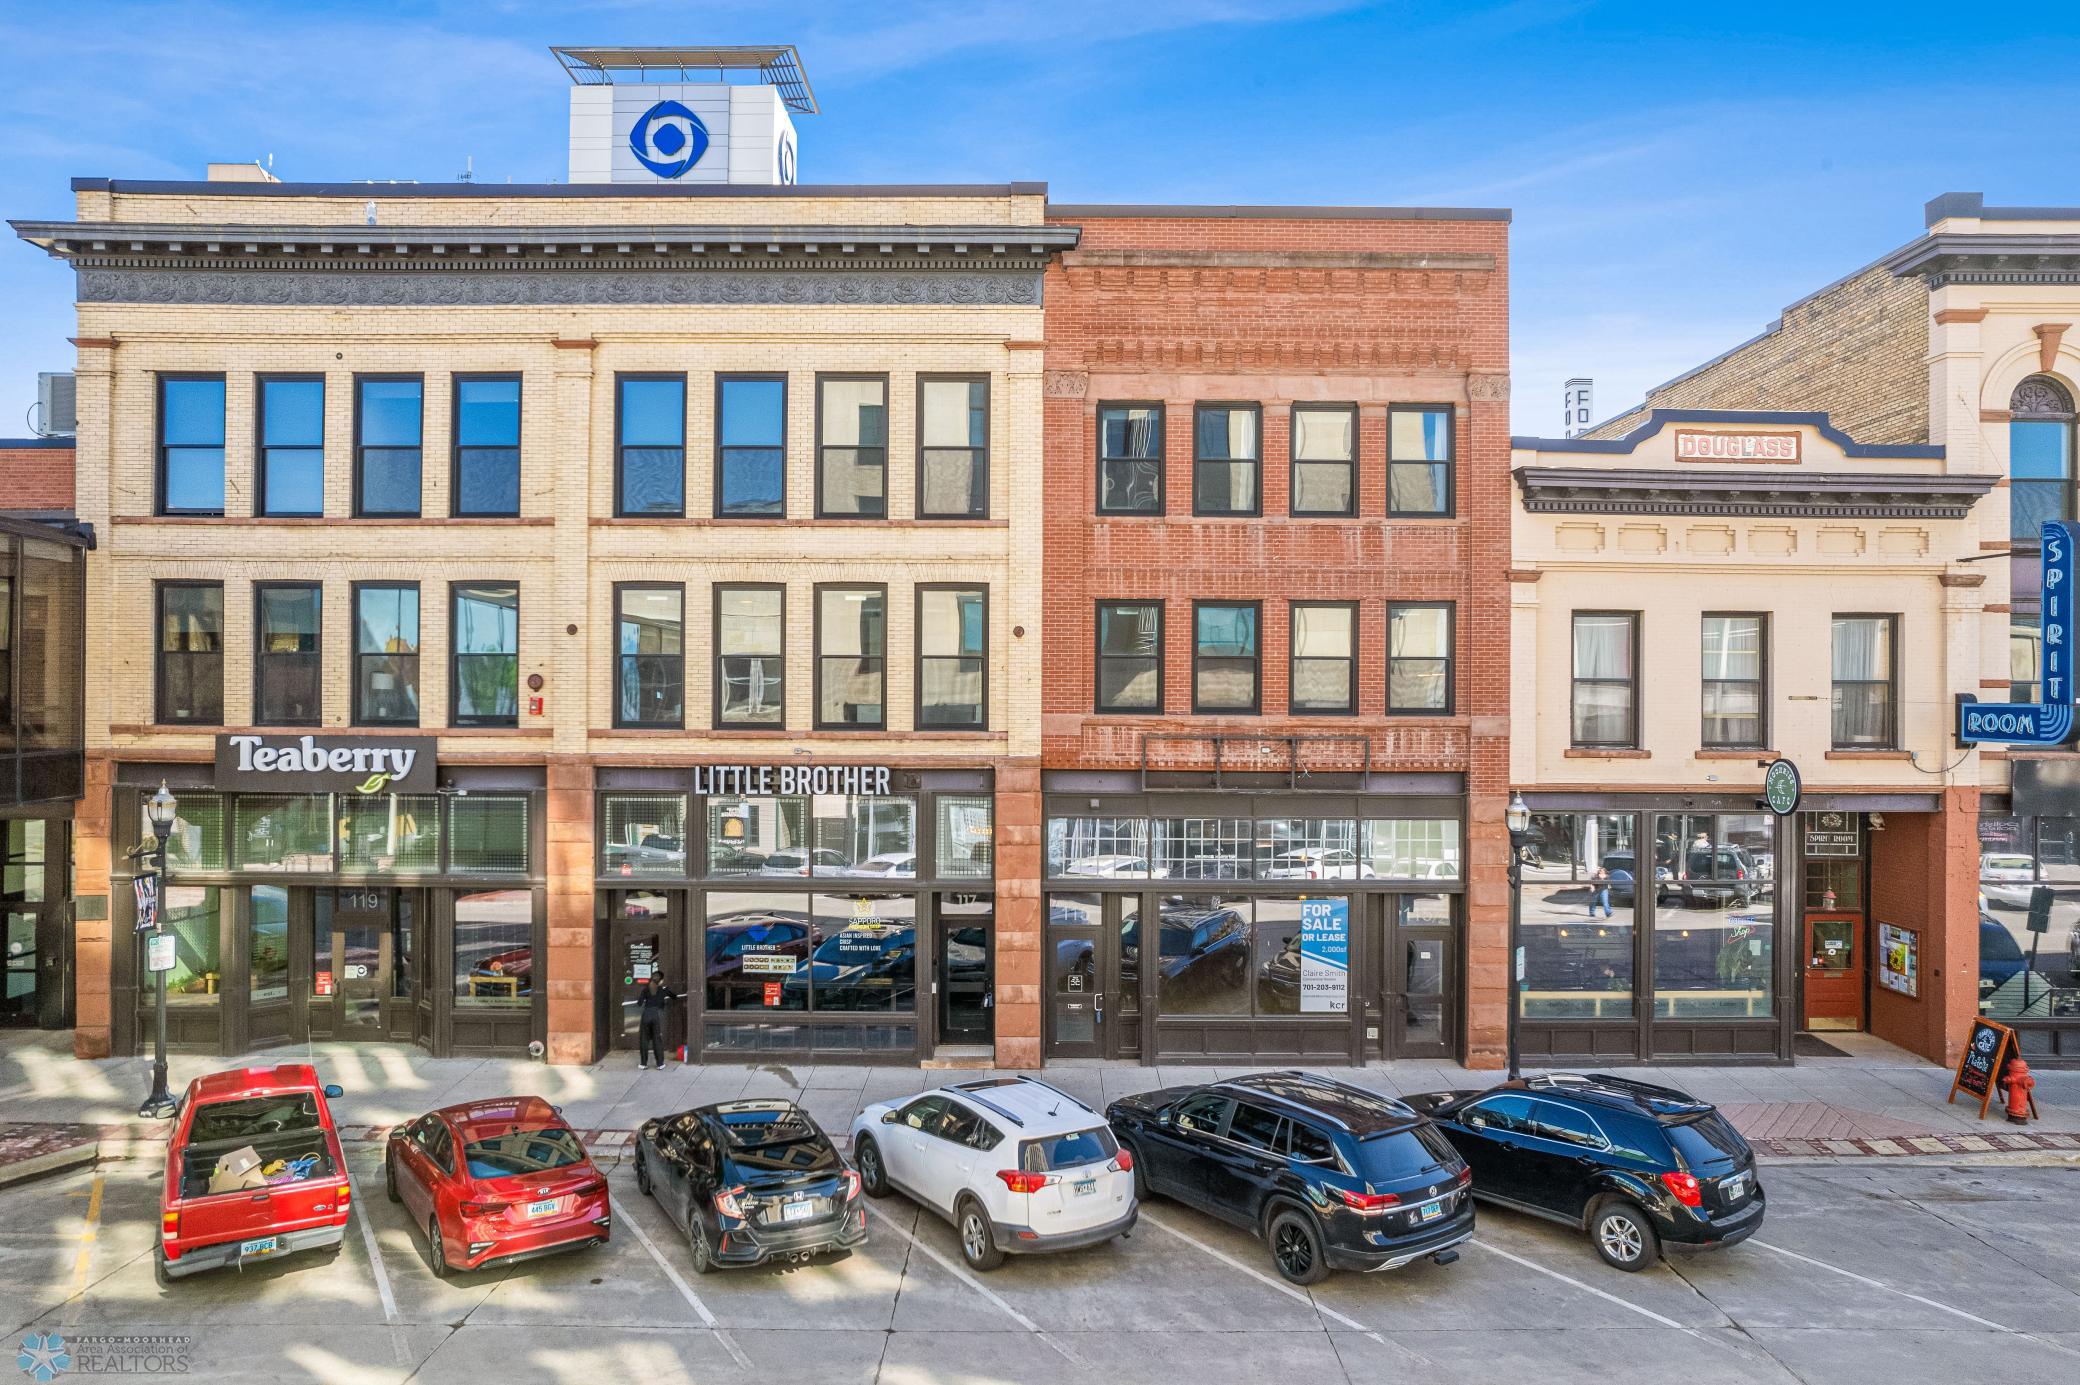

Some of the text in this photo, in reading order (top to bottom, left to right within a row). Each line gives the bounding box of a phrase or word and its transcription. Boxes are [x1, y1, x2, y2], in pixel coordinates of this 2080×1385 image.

[1683, 437, 1794, 457] DOUGLASS
[2047, 540, 2063, 699] SPIRIT
[1967, 712, 2035, 735] ROOM
[229, 736, 416, 781] Teaberry
[695, 766, 891, 795] LITTLE BROTHER
[350, 893, 378, 908] 119
[957, 894, 977, 905] 117
[1302, 904, 1332, 917] FOR
[848, 917, 881, 925] SAPPORO
[1302, 918, 1342, 931] SALE
[1302, 933, 1347, 942] OR LEASE
[1302, 969, 1346, 977] Claire Smith
[1329, 1001, 1346, 1009] kcr
[244, 1244, 258, 1253] 937
